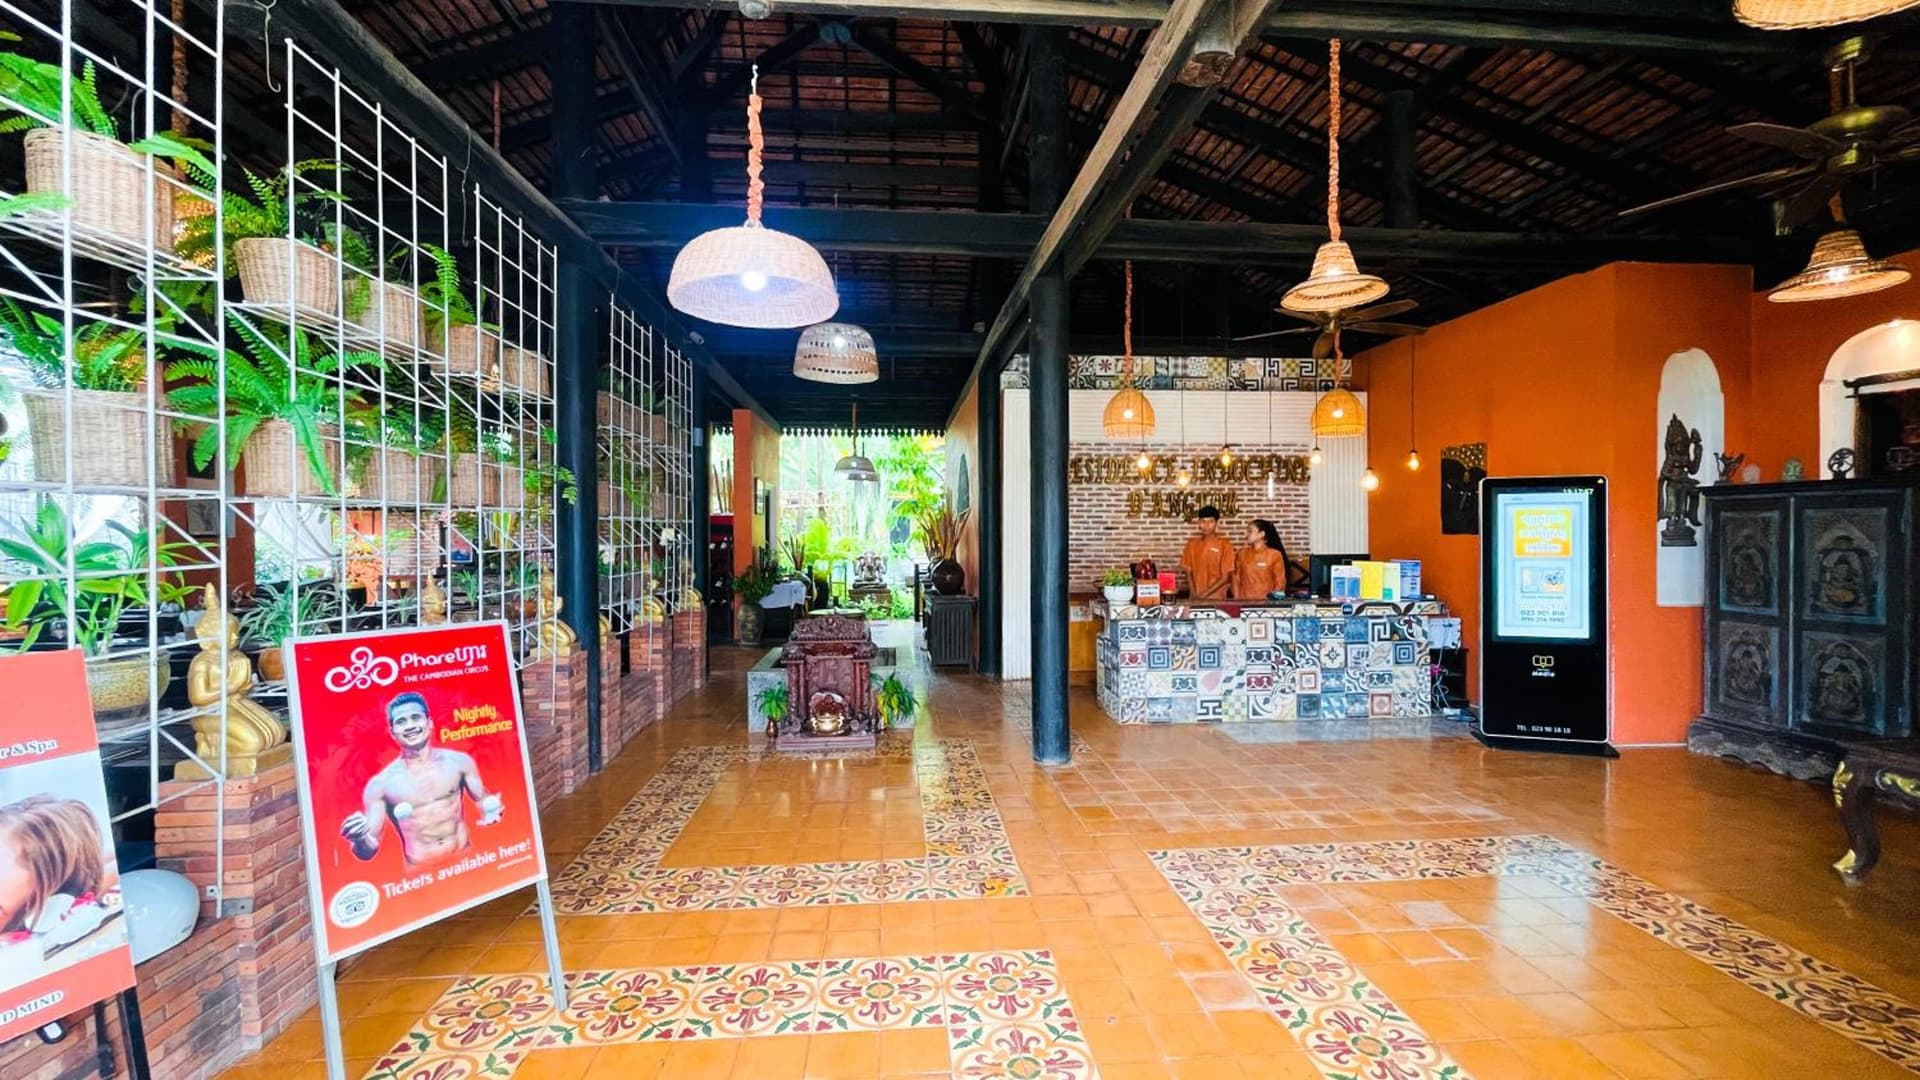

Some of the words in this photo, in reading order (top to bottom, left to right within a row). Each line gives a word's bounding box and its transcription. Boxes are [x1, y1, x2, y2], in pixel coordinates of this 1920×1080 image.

[1069, 453, 1177, 485] ESIDENCE
[400, 652, 456, 669] Phare
[403, 675, 419, 683] THE
[419, 668, 464, 681] CAMBODIAN
[464, 665, 489, 675] CIRCUS
[453, 704, 497, 723] Nightly
[440, 720, 513, 744] Performance
[28, 740, 57, 754] Spa
[382, 873, 433, 899] Tickets
[438, 851, 497, 880] available
[499, 839, 532, 859] here!
[19, 990, 63, 1017] MIND
